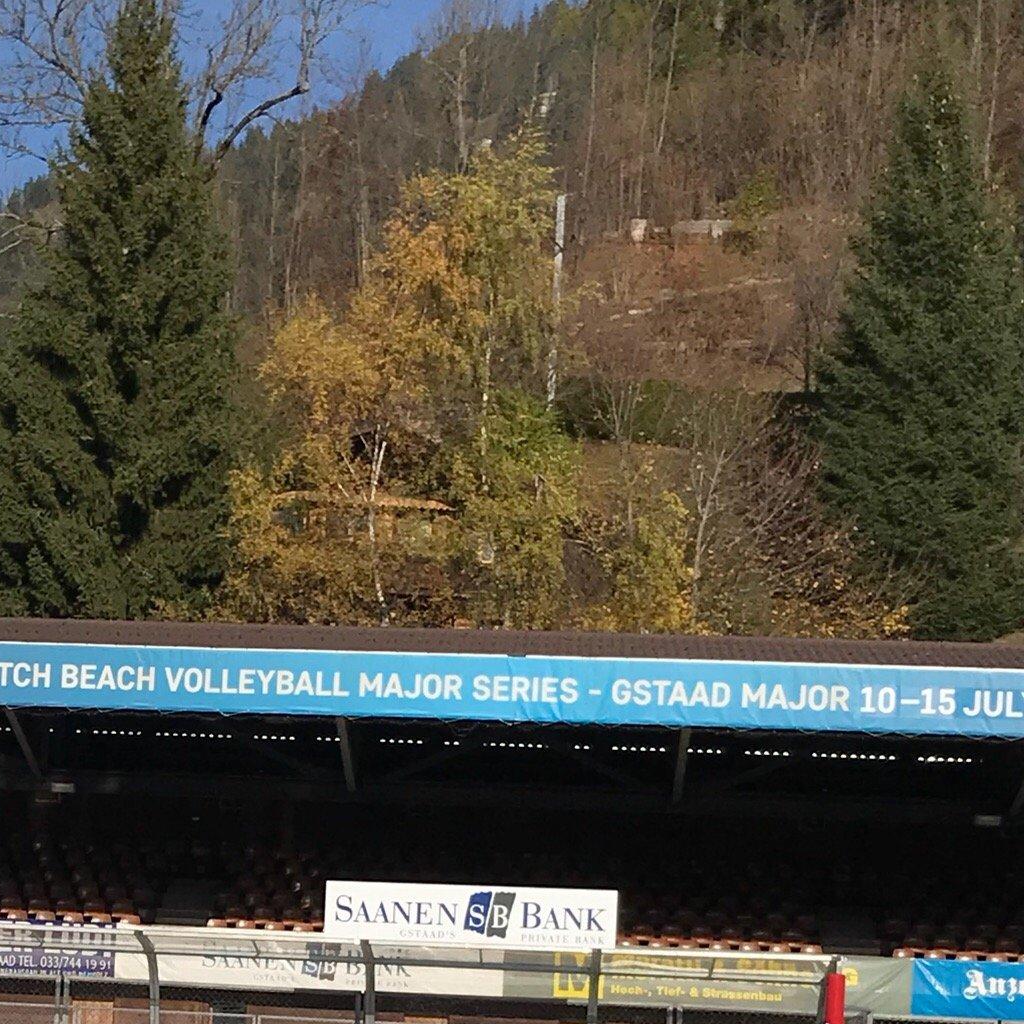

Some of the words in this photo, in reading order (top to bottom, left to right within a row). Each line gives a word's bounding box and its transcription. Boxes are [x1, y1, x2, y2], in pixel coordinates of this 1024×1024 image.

[61, 663, 156, 692] BEACH
[164, 667, 351, 698] VOLLEYBALL
[358, 672, 463, 701] MAJOR
[472, 674, 579, 704] SERIES
[611, 678, 732, 709] GSTAAD
[740, 682, 851, 713] MAJOR
[335, 894, 458, 927] SAANEN
[521, 901, 608, 933] BANK
[399, 929, 457, 940] GSTAAD'S
[520, 933, 570, 946] PRIVATE
[575, 936, 606, 947] BANK
[19, 957, 38, 968] TEL.
[40, 957, 82, 970] 033/744
[86, 960, 98, 969] 19
[346, 948, 411, 977] BNK
[611, 984, 652, 997] Hoch-,
[657, 986, 685, 997] Tief-
[690, 986, 698, 998] &
[702, 987, 782, 1002] Strassenbau
